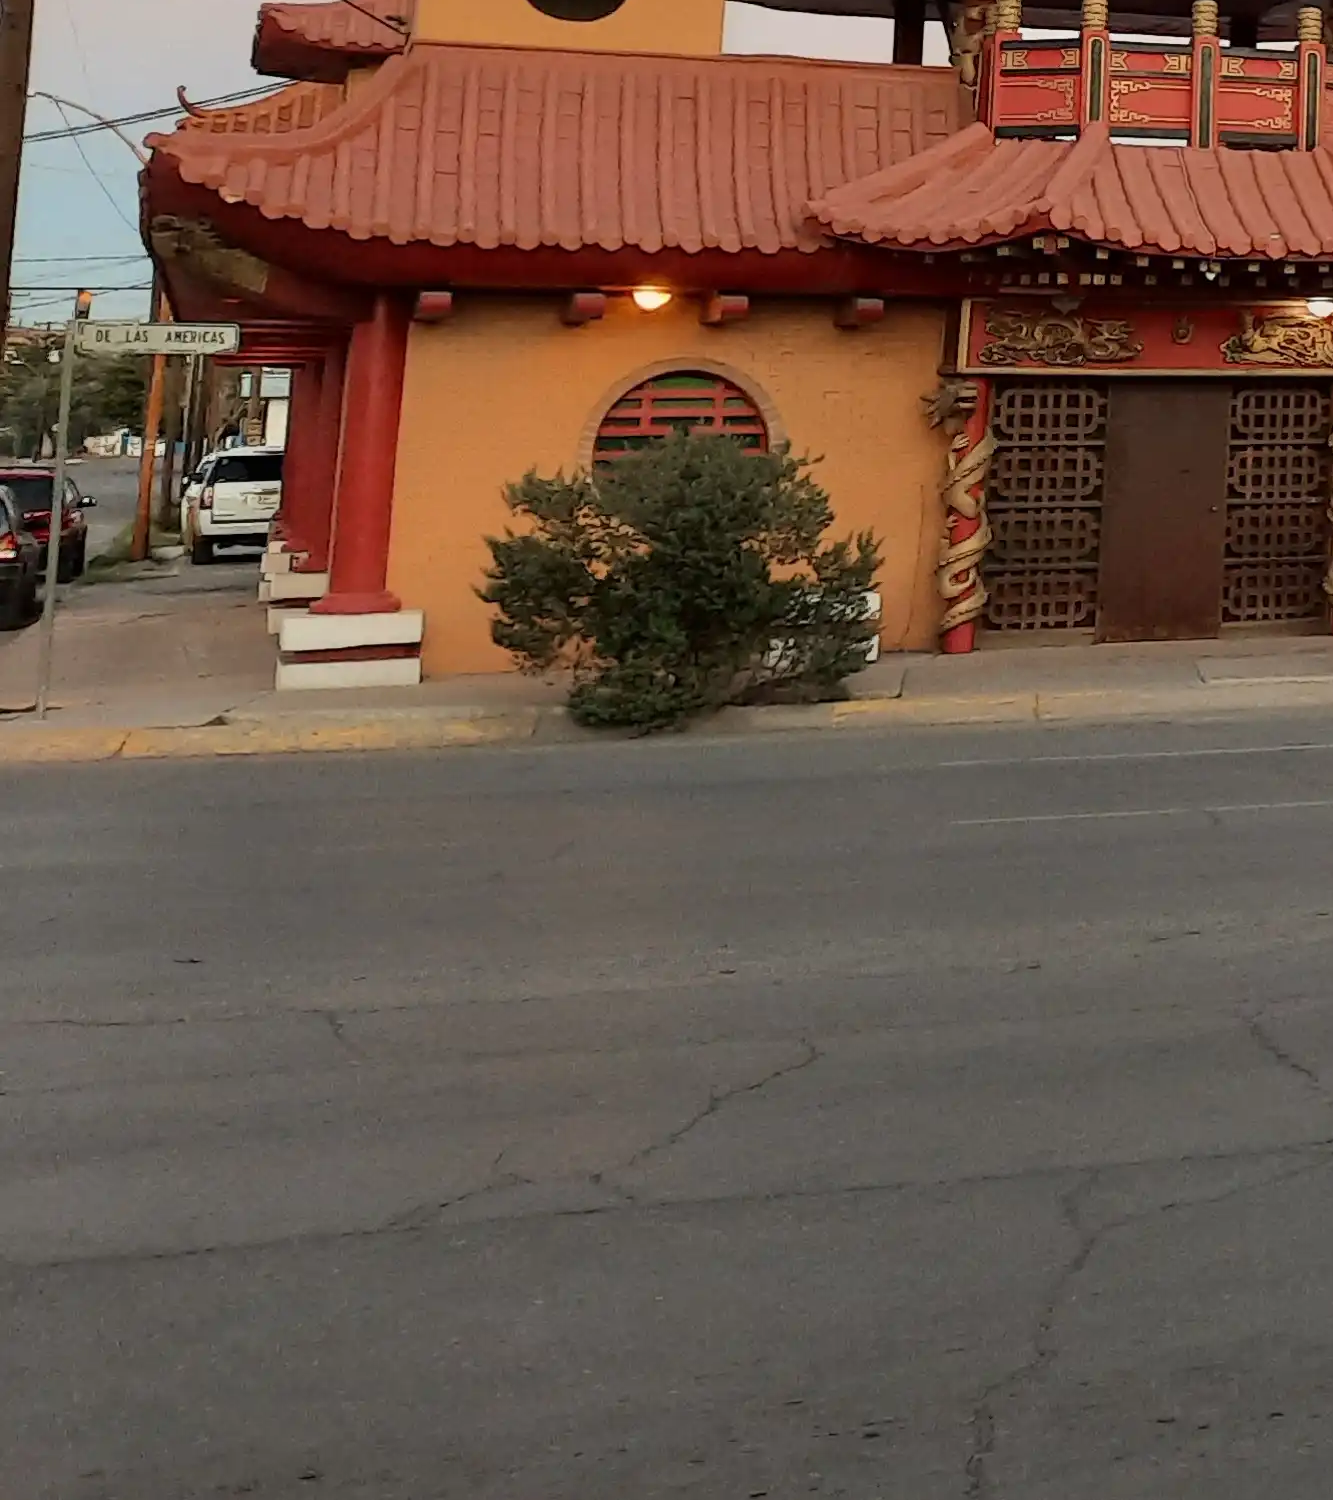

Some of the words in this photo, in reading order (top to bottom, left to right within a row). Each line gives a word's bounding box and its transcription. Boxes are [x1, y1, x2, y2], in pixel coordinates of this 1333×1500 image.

[95, 329, 111, 343] DE
[125, 329, 149, 344] LAS
[164, 330, 226, 345] AMERICAS
